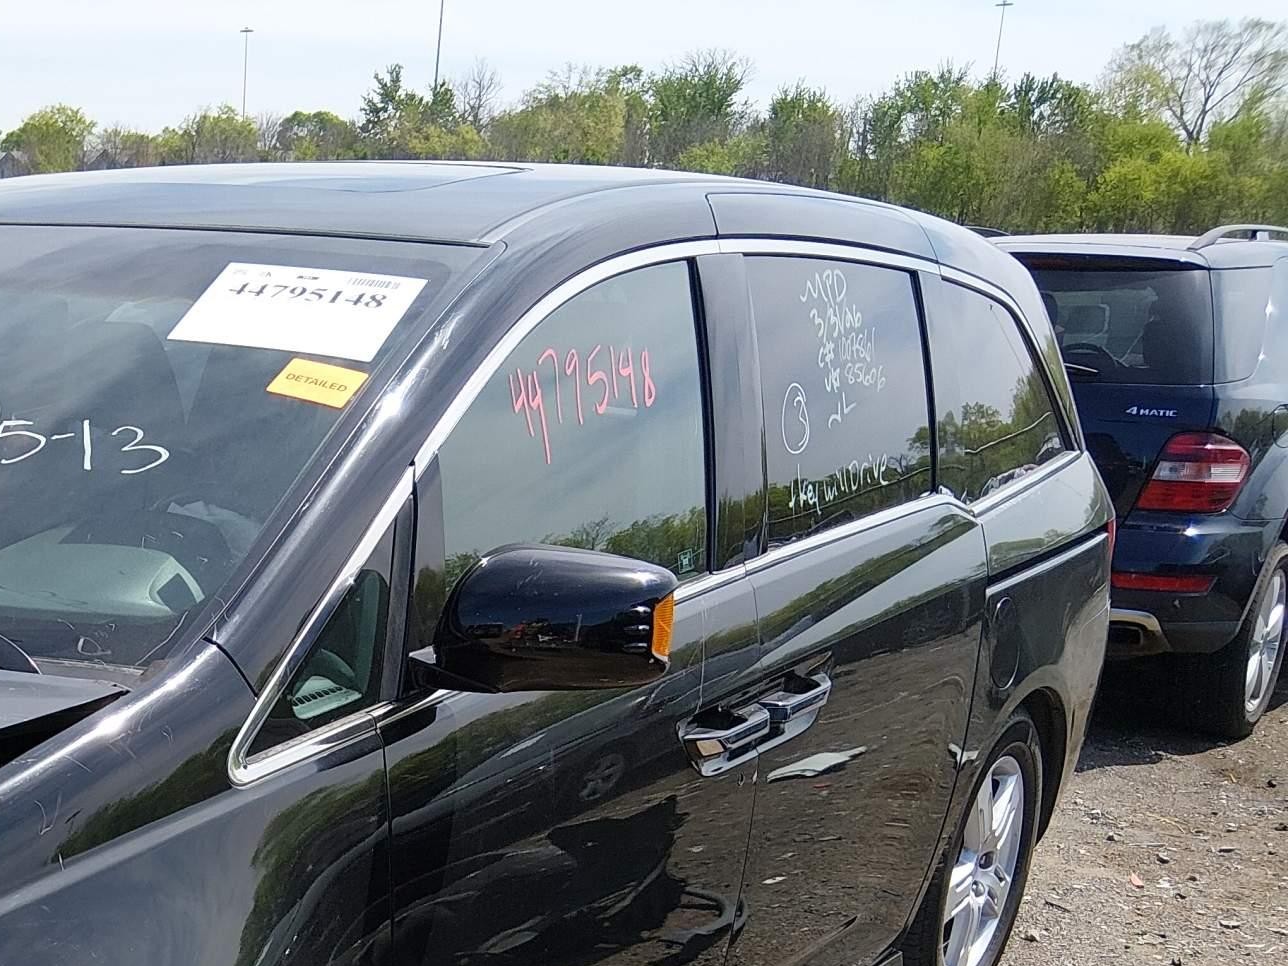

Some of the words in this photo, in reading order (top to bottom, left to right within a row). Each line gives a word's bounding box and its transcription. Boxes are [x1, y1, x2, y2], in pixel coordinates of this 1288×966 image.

[228, 281, 388, 309] 44795148
[285, 372, 348, 394] DETAILED
[510, 345, 655, 464] 44795148
